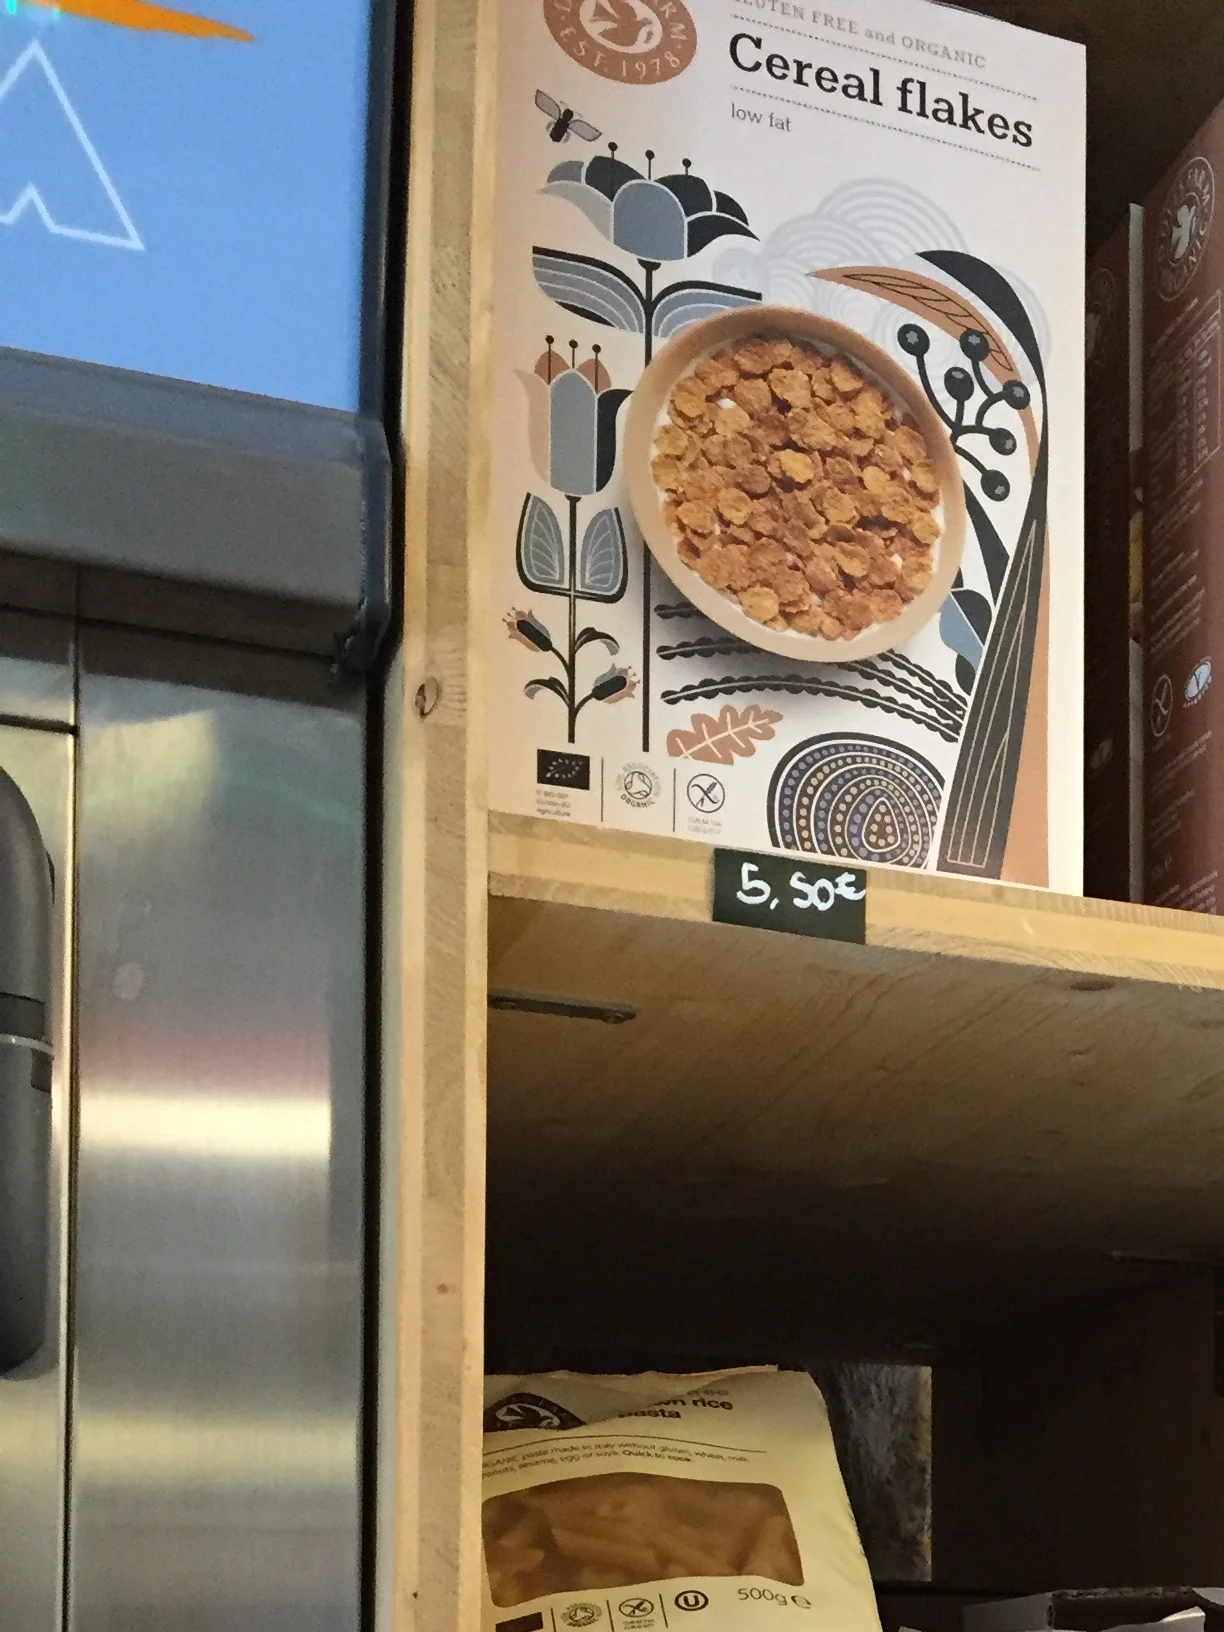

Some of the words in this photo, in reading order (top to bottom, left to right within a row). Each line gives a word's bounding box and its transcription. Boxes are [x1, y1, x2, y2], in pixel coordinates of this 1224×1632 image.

[733, 0, 804, 20] LUTEN
[811, 10, 859, 35] FREE
[864, 28, 897, 44] and
[901, 35, 987, 69] ORGANIC
[618, 50, 682, 81] 1978
[728, 32, 884, 107] Cereal
[897, 77, 1035, 149] flakes
[730, 102, 763, 128] low
[767, 108, 792, 133] fat
[737, 1586, 788, 1608] 500g
